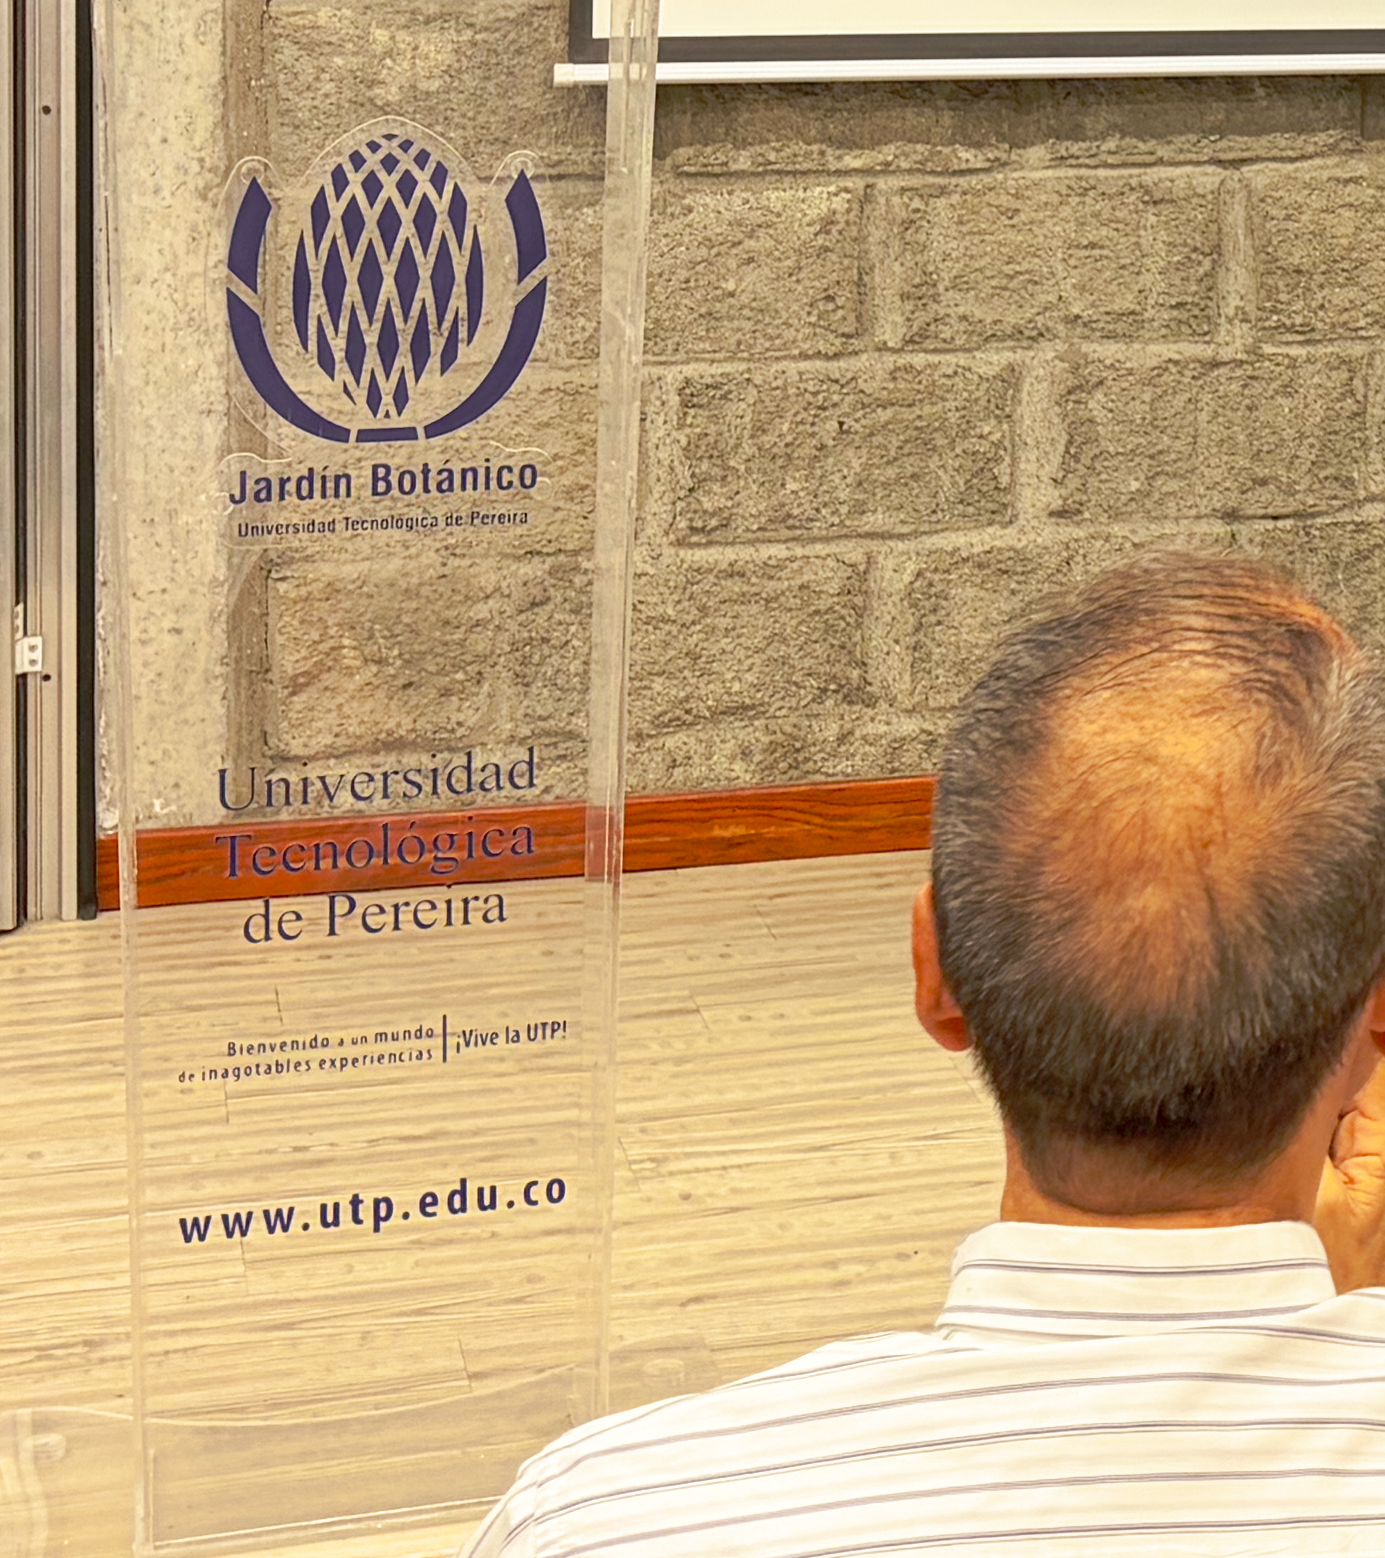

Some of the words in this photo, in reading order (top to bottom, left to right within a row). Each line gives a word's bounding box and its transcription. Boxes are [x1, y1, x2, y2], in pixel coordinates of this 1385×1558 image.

[229, 463, 352, 506] Jardín
[370, 457, 538, 497] Botánico
[237, 518, 336, 538] Universidad
[445, 511, 464, 527] de
[470, 510, 528, 526] Pereira
[218, 746, 537, 812] Universidad
[215, 815, 535, 880] Tecnológica
[243, 898, 303, 944] de
[327, 884, 508, 937] Pereira
[227, 1033, 331, 1057] Bienvenido
[337, 1036, 346, 1048] a
[351, 1035, 368, 1046] un
[374, 1024, 435, 1044] mundo
[456, 1028, 499, 1053] ¡Vive
[504, 1025, 521, 1045] la
[526, 1020, 568, 1042] UTP!
[178, 1069, 195, 1084] de
[201, 1056, 311, 1082] inagotables
[319, 1046, 434, 1072] experiencias
[178, 1177, 567, 1244] www.utp.edu.co
